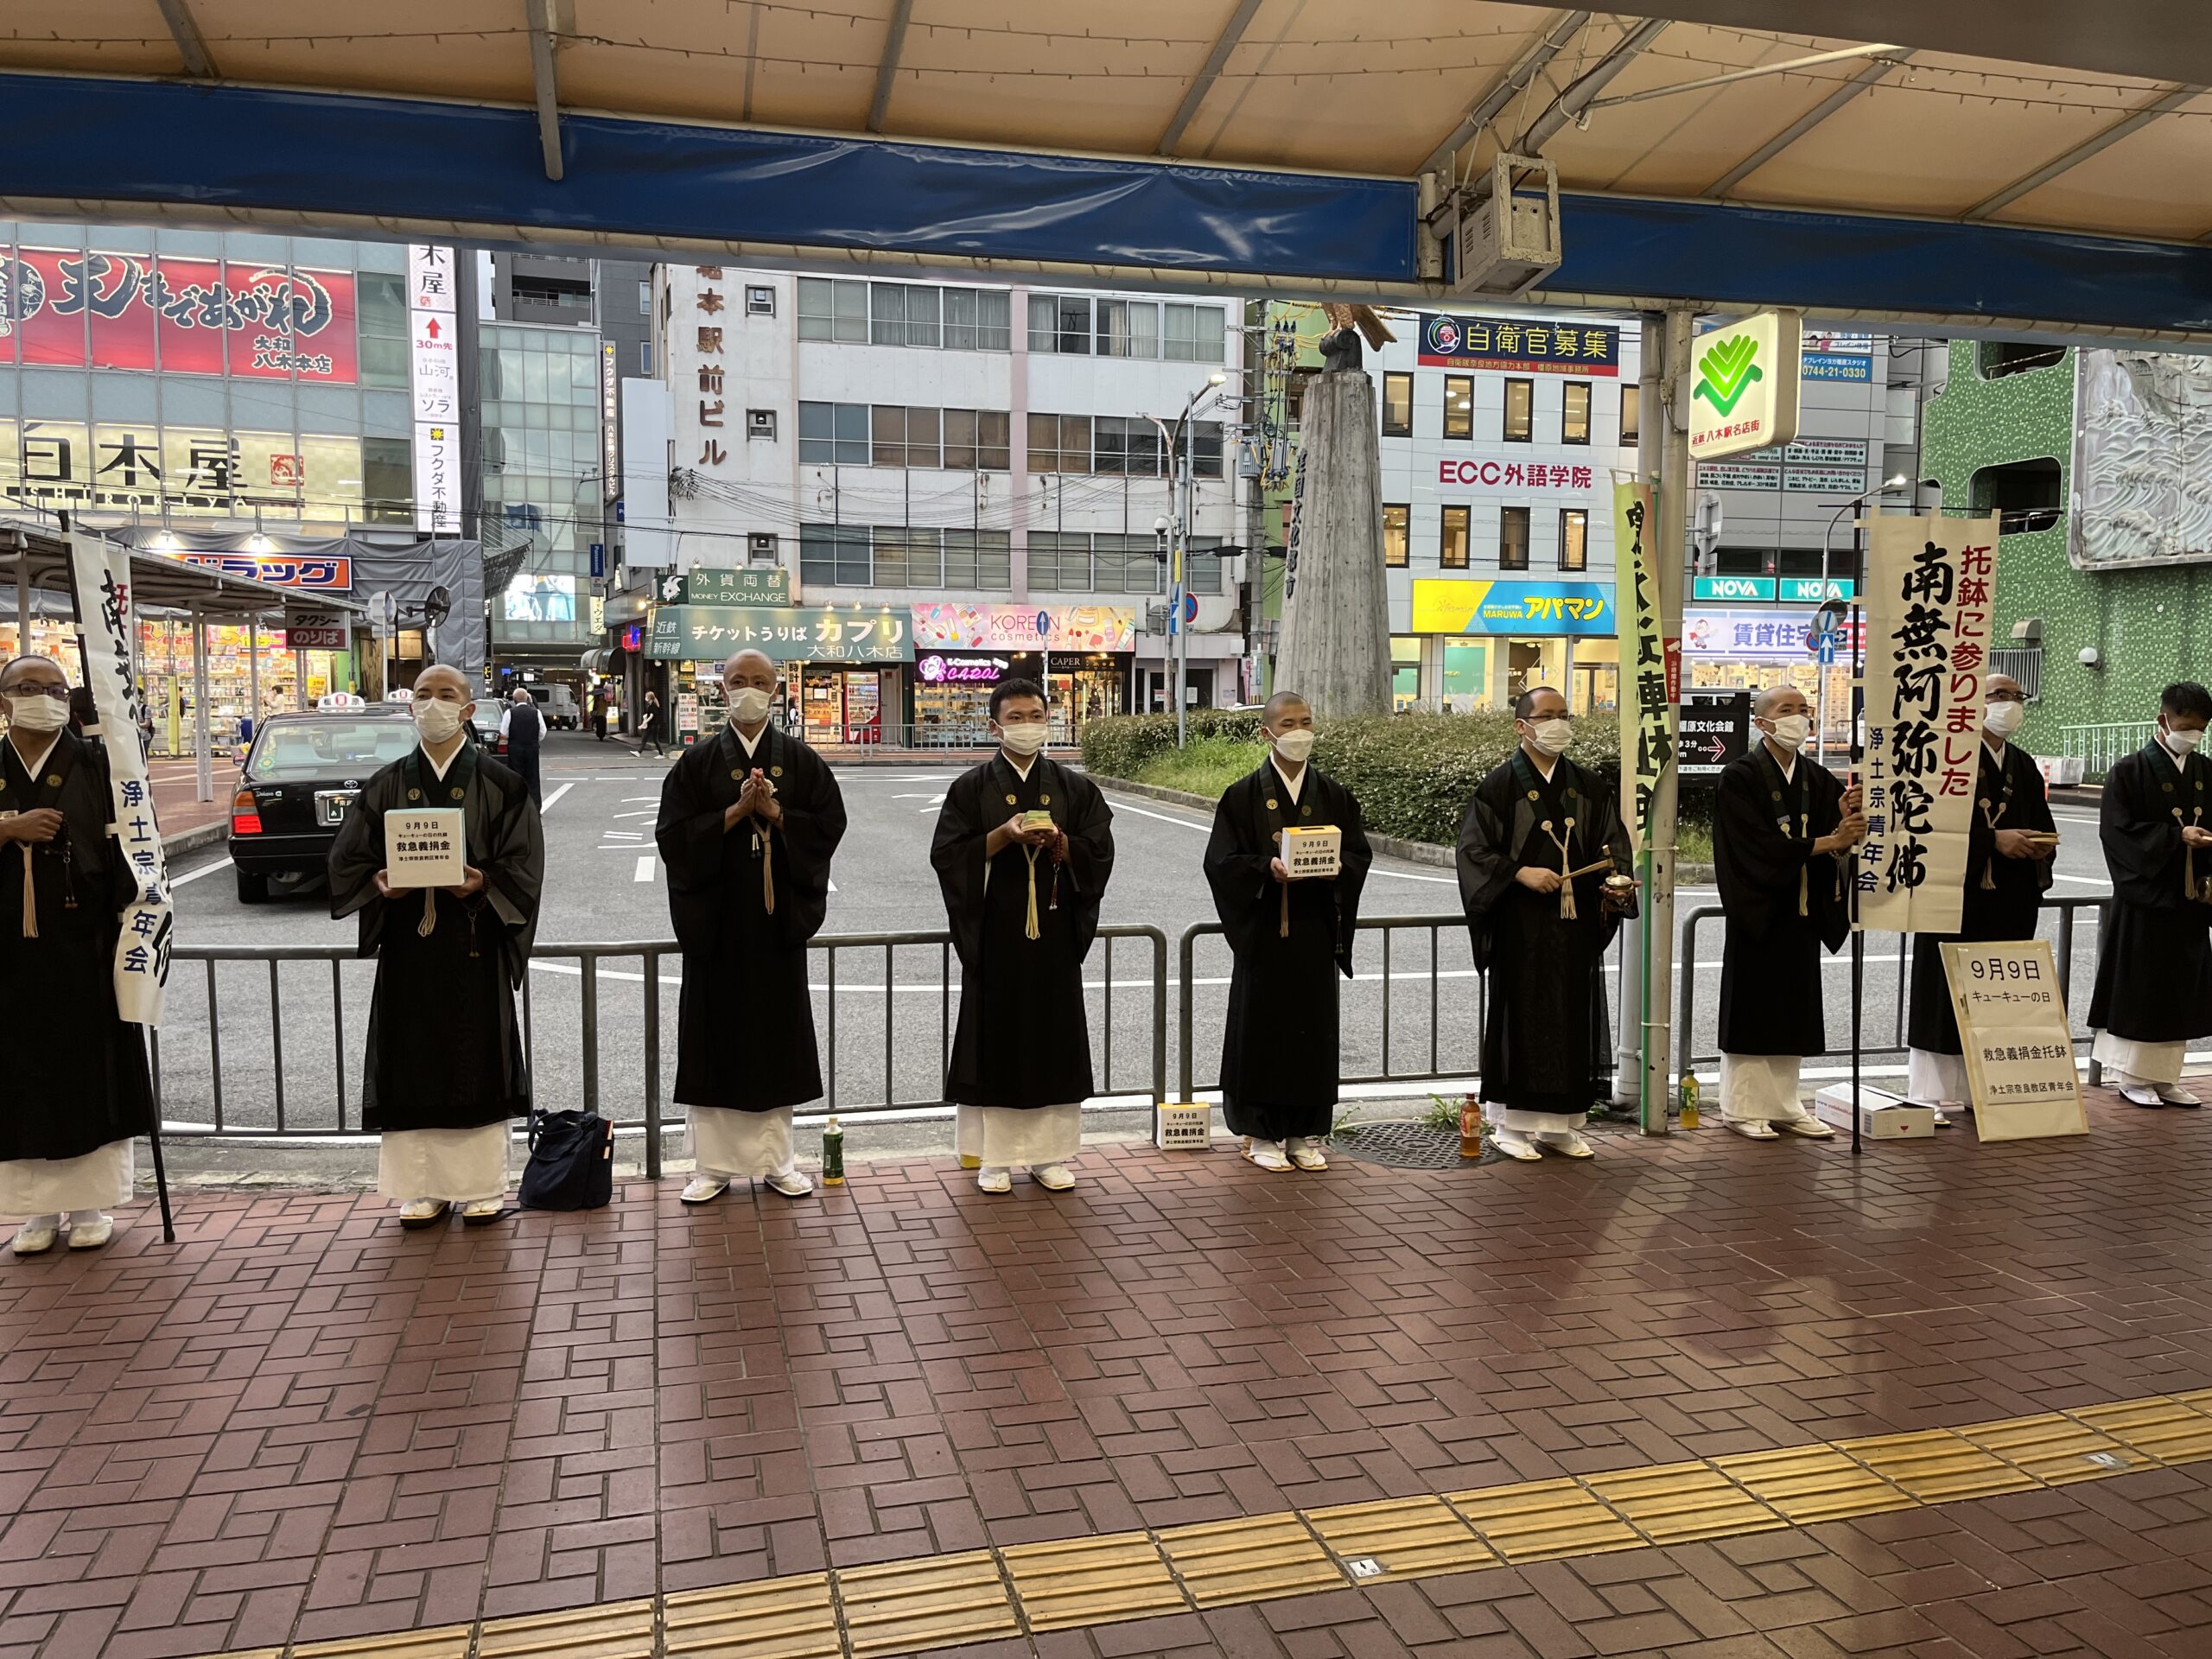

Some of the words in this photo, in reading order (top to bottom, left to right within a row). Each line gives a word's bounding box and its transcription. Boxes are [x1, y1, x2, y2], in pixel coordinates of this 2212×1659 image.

[1467, 323, 1607, 359] 自衛官募集
[1802, 366, 1866, 378] 0744-21-0330
[24, 423, 248, 491] 白木屋
[1440, 461, 1592, 488] ECC外語学院
[431, 445, 447, 527] フクダ不動産
[696, 574, 781, 588] 外貨両替
[1712, 580, 1758, 597] NOVA
[721, 592, 786, 602] EXCHANGE
[1483, 610, 1522, 619] MARUWA
[1523, 596, 1604, 620] アパマン
[295, 614, 340, 626] タクシー
[656, 620, 677, 634] 近鉄
[991, 615, 1060, 631] KOREN
[294, 630, 339, 645] のりば
[691, 625, 808, 642] チケットうりば
[815, 619, 904, 643] カプリ
[806, 645, 903, 658] 大和八木店
[1051, 657, 1081, 666] CAPER
[1939, 545, 1992, 797] 托鉢に参りました
[1886, 541, 1955, 898] 南無阿弥陀佛
[1857, 728, 1888, 893] 浄土宗青年会
[397, 842, 450, 852] 救急義捐金
[1294, 856, 1335, 866] 救急義捐金
[1971, 958, 2040, 981] 9月9日
[1972, 991, 2050, 1002] キューキューの日
[1983, 1045, 2067, 1062] 救急義捐金托鉢
[1989, 1081, 2074, 1096] 浄土宗奈良教区青年会
[1165, 1128, 1205, 1136] 救急義捐金
